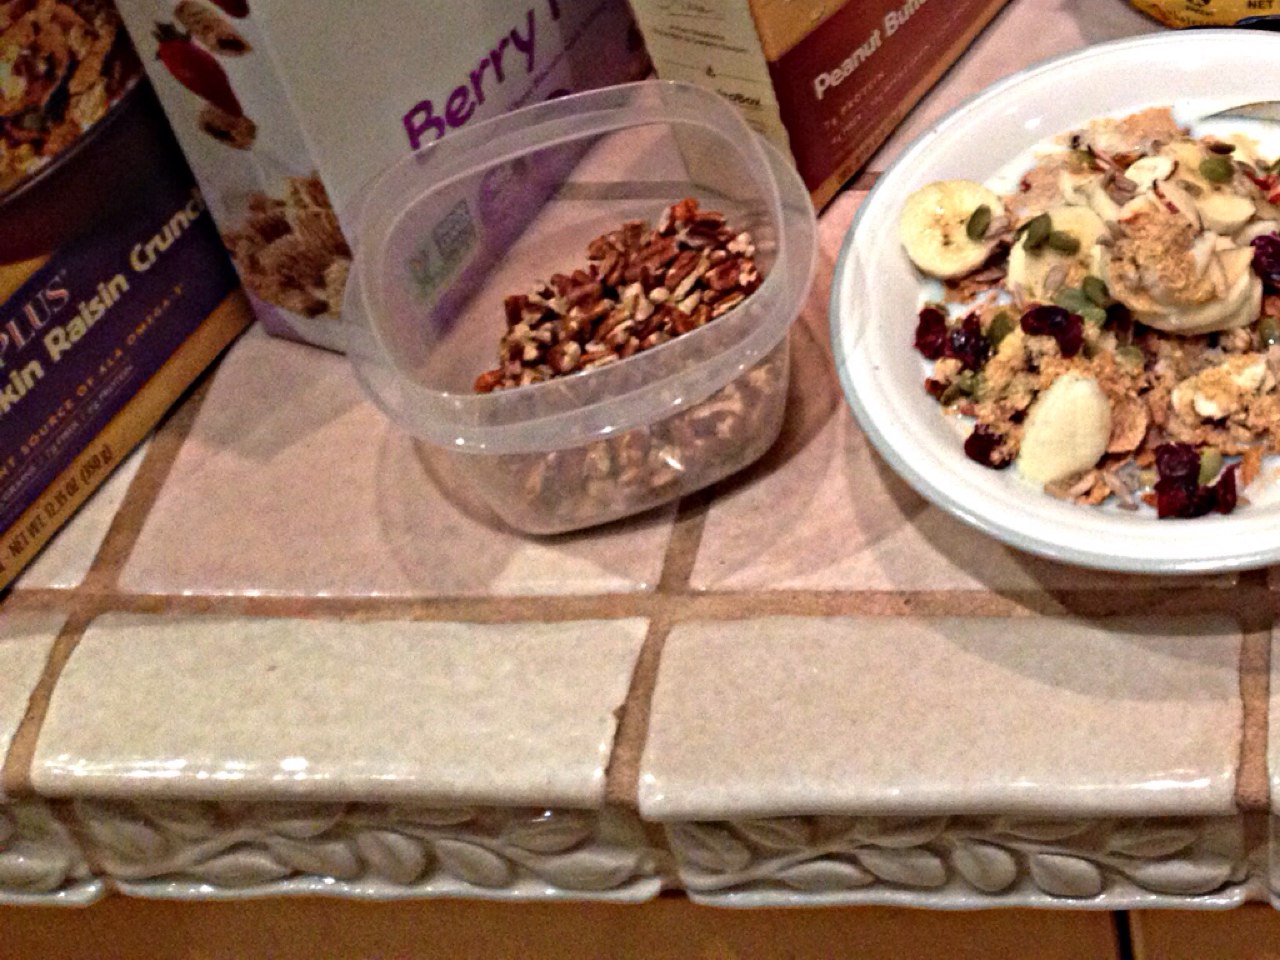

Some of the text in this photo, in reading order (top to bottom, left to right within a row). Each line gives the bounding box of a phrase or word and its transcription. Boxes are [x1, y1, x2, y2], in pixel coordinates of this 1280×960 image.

[1246, 0, 1275, 10] NET
[403, 8, 536, 151] Berry
[812, 28, 884, 101] Peanut
[43, 273, 130, 363] Raisin
[129, 197, 206, 273] Crunc
